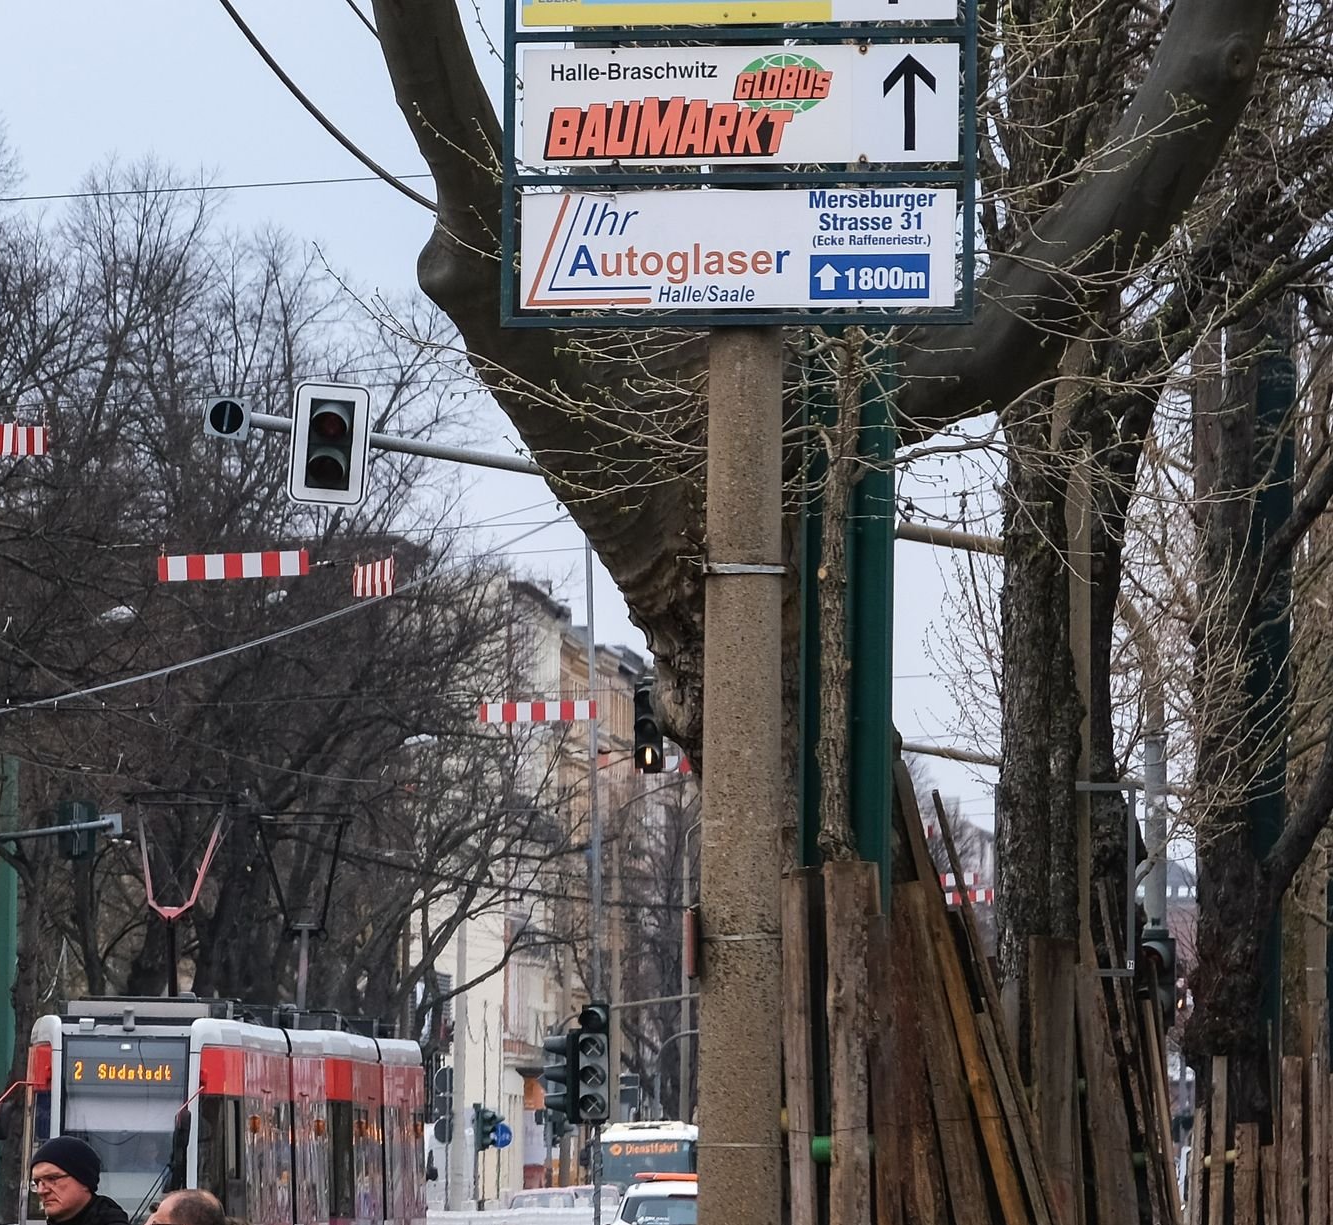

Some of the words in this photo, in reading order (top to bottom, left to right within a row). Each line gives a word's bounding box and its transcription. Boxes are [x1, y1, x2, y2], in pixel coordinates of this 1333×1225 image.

[550, 61, 718, 82] Halle-Braschwitz
[734, 65, 833, 100] GLOBUS
[543, 97, 794, 161] BAUMARKT
[809, 190, 937, 212] Merseburger
[583, 202, 639, 236] Ihr
[819, 213, 892, 231] Strasse
[900, 212, 923, 230] 31
[812, 235, 845, 248] (Ecke
[567, 243, 791, 285] Autoglaser
[844, 266, 926, 290] 1800m
[658, 285, 755, 303] Halle/Saale
[74, 1060, 83, 1080] 2
[98, 1063, 172, 1081] Südstadt
[625, 1142, 678, 1155] Dienstfahrt
